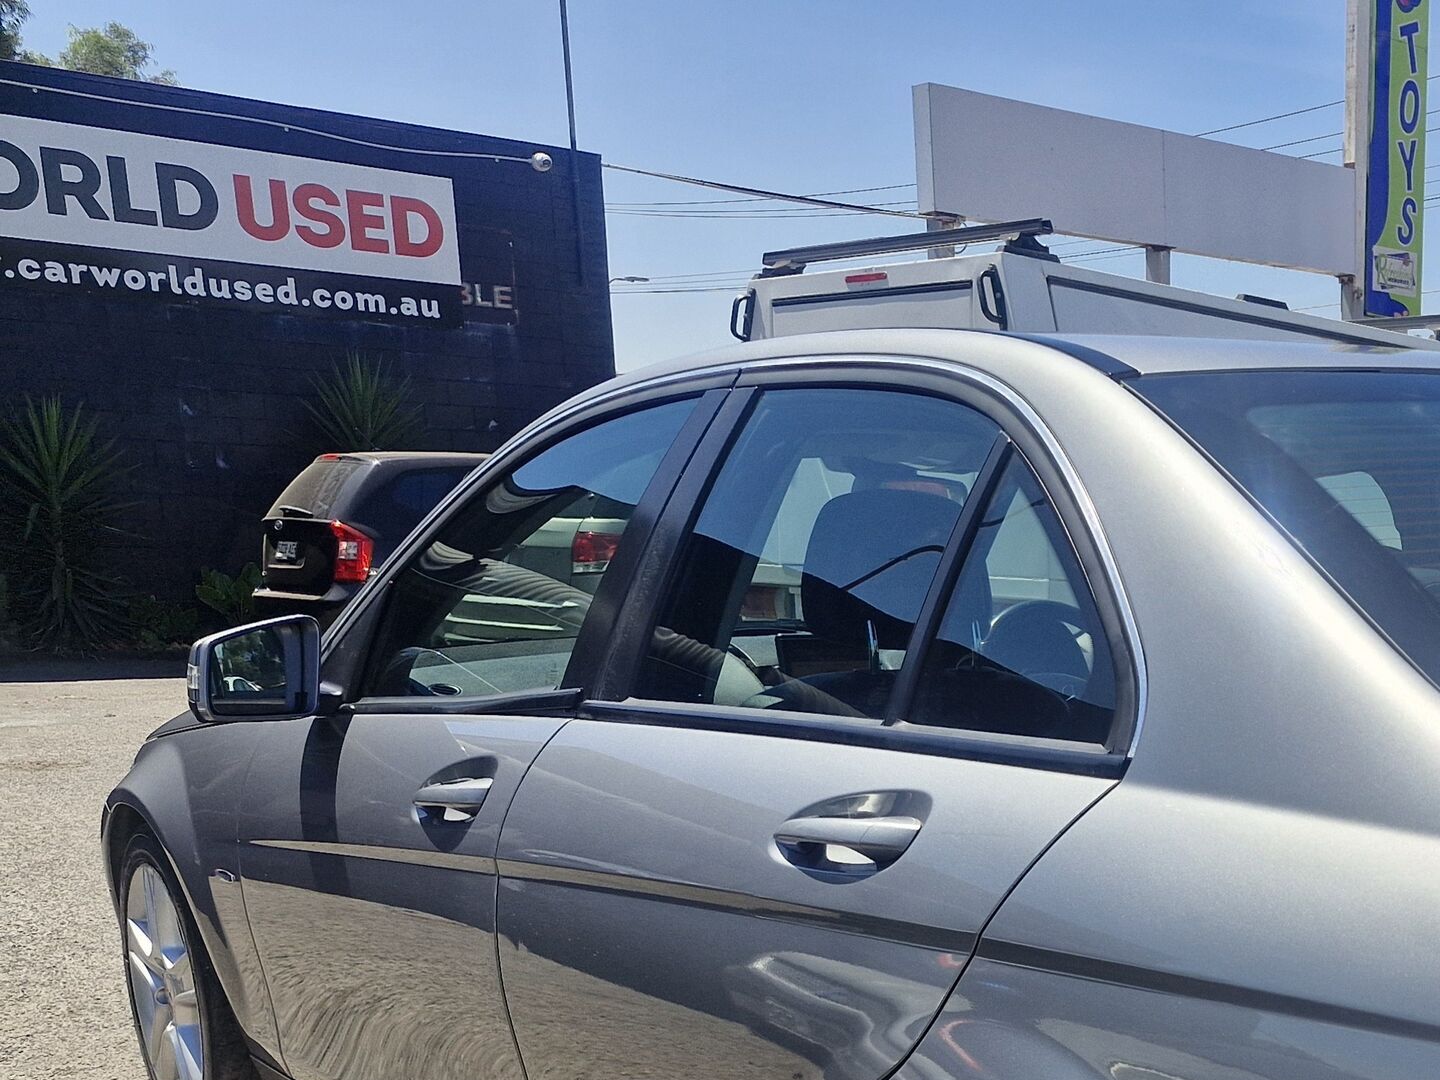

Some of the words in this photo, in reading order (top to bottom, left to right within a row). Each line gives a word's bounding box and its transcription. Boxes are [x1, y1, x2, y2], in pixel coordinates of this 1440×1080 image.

[1397, 21, 1419, 245] TOYS
[233, 174, 444, 257] USED
[0, 257, 440, 319] .carworldused.com.au
